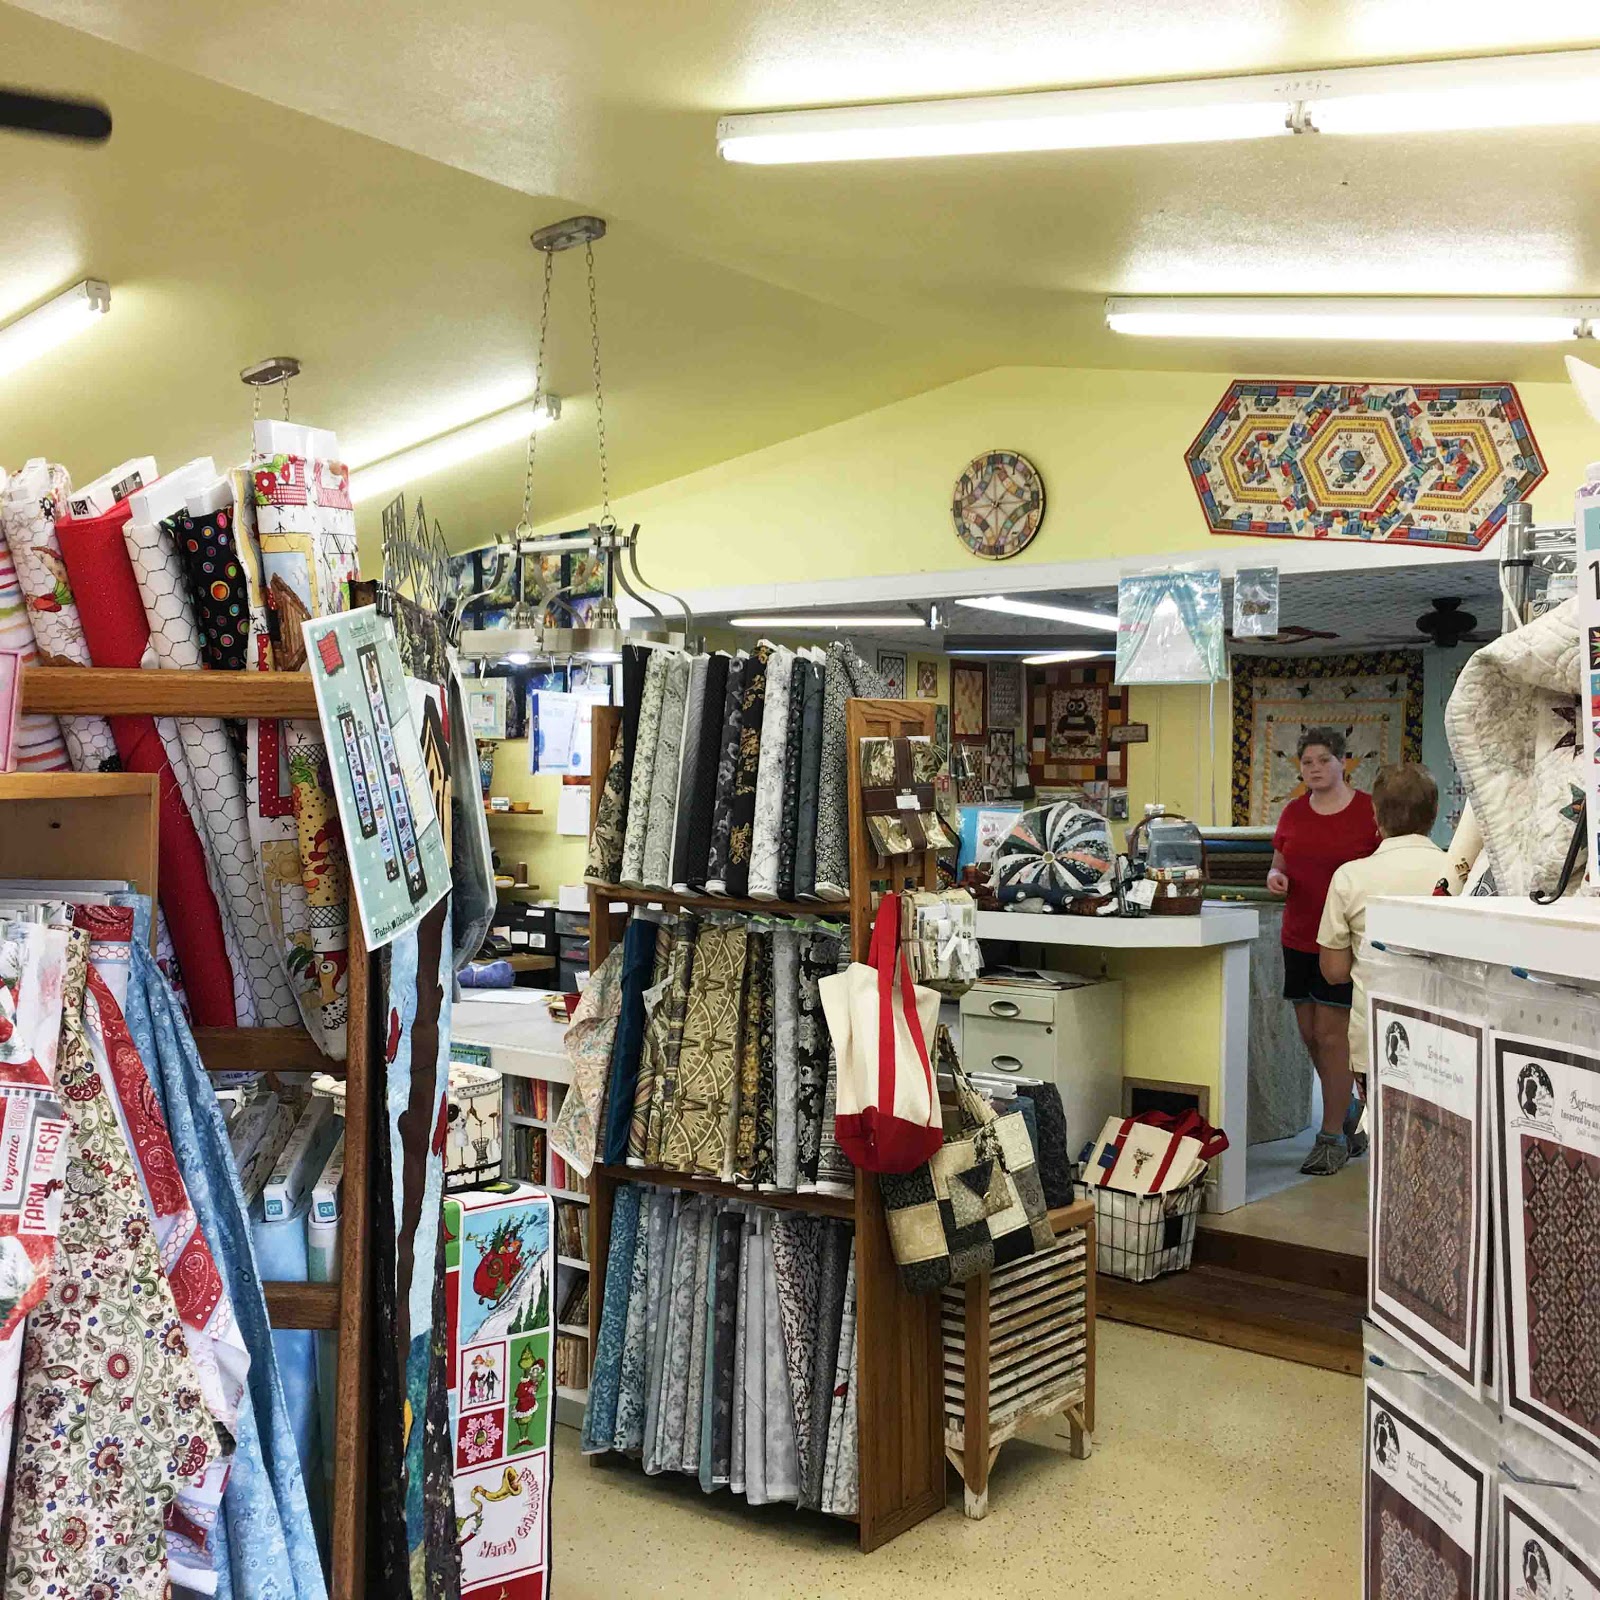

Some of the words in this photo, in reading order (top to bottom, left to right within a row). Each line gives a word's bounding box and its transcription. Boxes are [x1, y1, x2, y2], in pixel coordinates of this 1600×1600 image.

[33, 1121, 67, 1173] FRESH
[23, 1183, 47, 1231] FARM
[516, 1467, 541, 1539] Grinchmas
[478, 1537, 517, 1558] Merry
